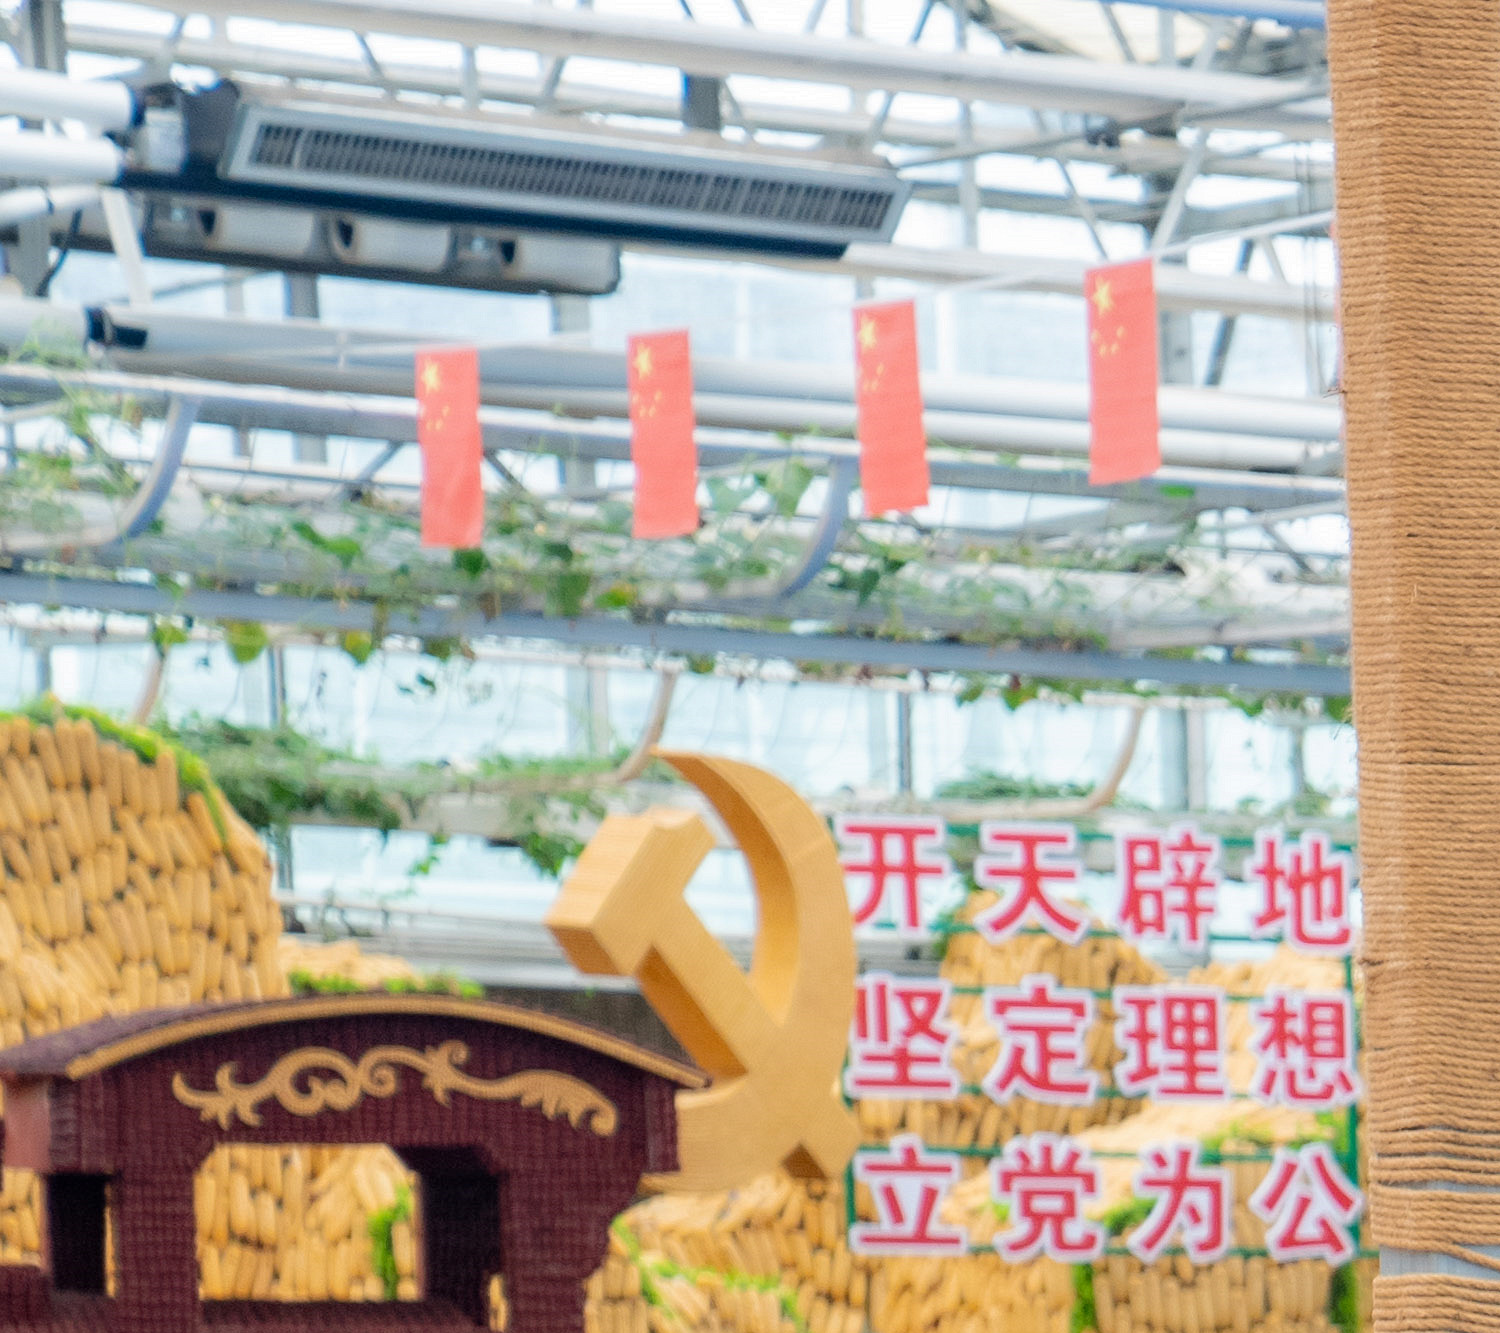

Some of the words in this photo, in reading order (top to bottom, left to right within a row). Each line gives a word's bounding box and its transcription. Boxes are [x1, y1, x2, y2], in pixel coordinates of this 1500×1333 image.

[840, 820, 1354, 952] 开天辟地
[852, 976, 1358, 1104] 坚定理想
[854, 1140, 1358, 1260] 立党为公
